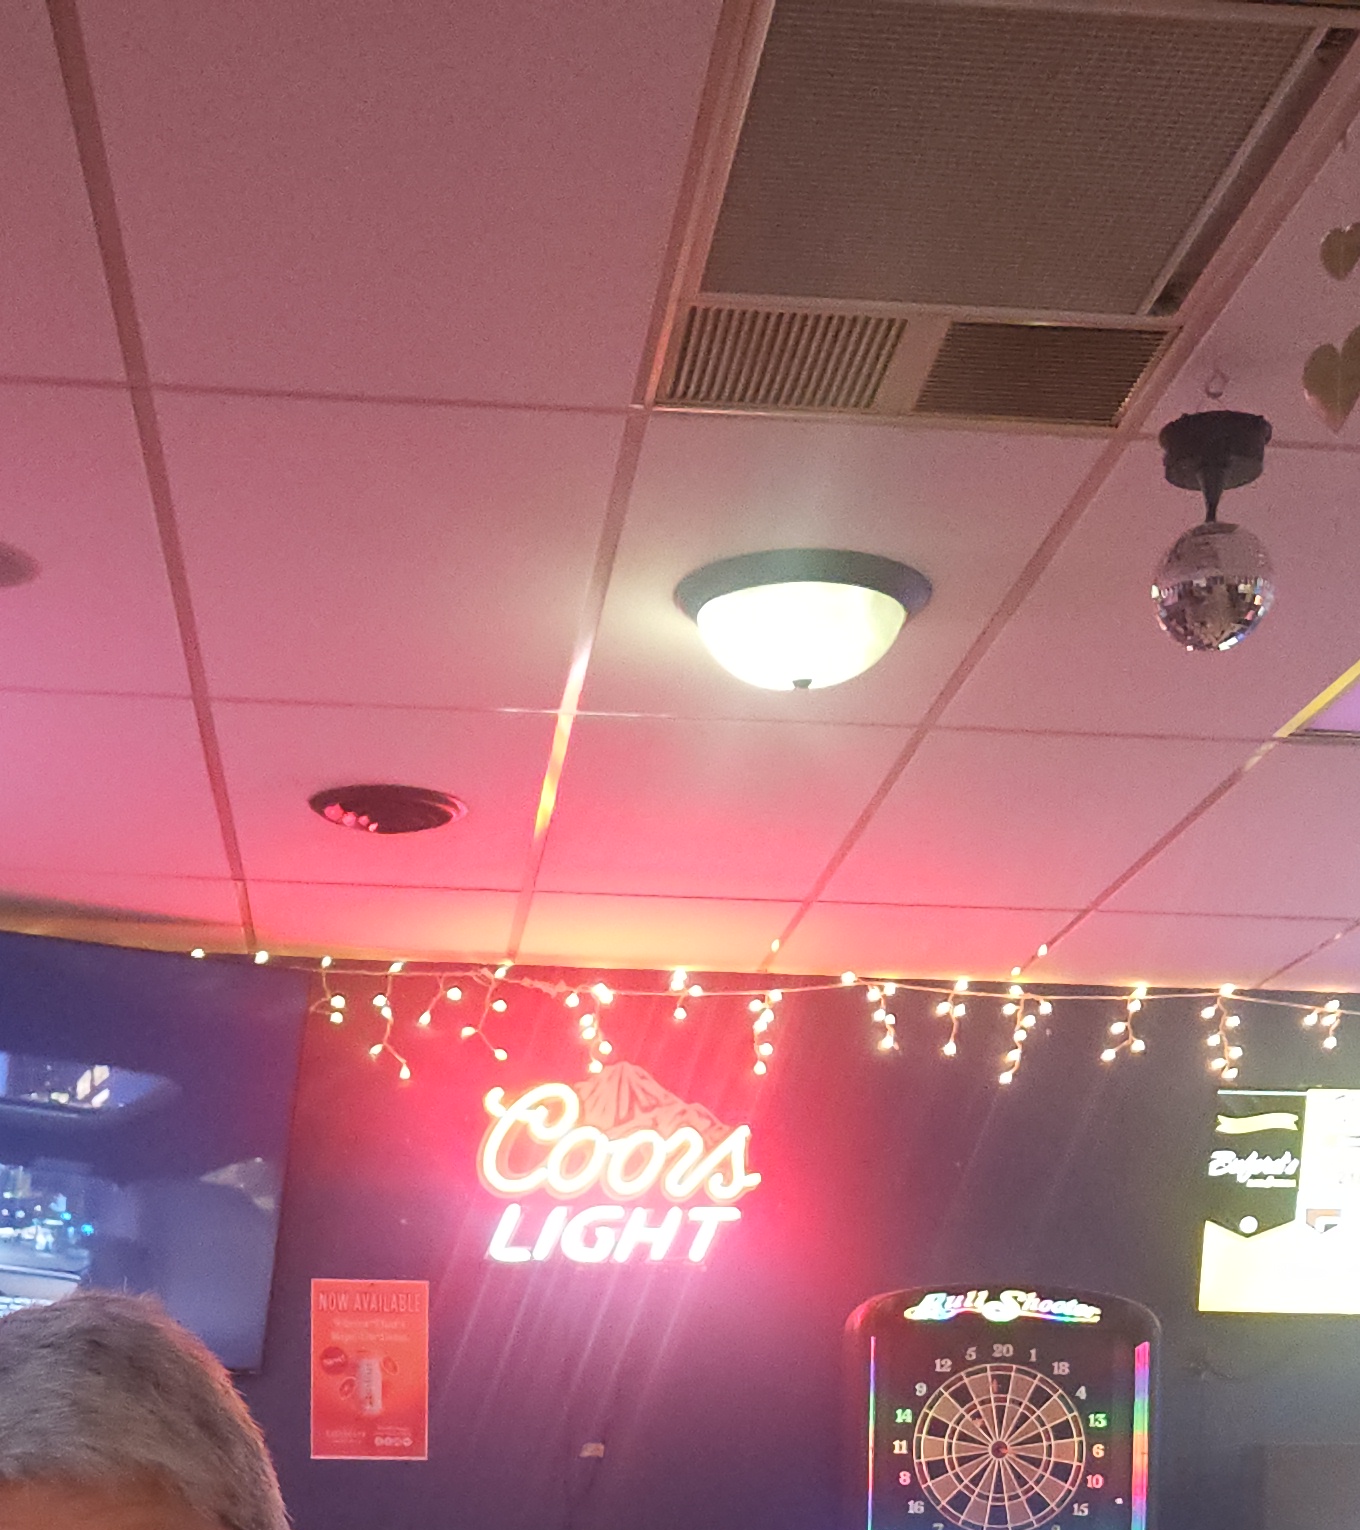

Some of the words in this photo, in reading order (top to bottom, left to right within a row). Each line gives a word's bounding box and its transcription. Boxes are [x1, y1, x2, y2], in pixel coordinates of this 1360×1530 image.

[483, 1083, 762, 1201] Coors
[490, 1203, 742, 1263] LIGHT
[319, 1292, 348, 1312] NOW
[353, 1292, 421, 1313] AVAILABLE
[903, 1289, 989, 1321] Bull
[981, 1289, 1101, 1323] Shooter
[965, 1347, 977, 1360] 5
[992, 1344, 1013, 1357] 20
[1029, 1349, 1037, 1361] 1
[934, 1358, 952, 1372] 12
[1052, 1362, 1070, 1375] 18
[915, 1383, 927, 1396] 9
[1075, 1386, 1087, 1400] 4
[895, 1408, 913, 1423] 14
[1088, 1414, 1108, 1428] 13
[892, 1440, 908, 1455] 11
[1092, 1444, 1105, 1458] 6
[898, 1471, 911, 1486] 8
[1086, 1474, 1104, 1488] 10
[907, 1500, 925, 1514] 16
[1072, 1503, 1089, 1517] 15
